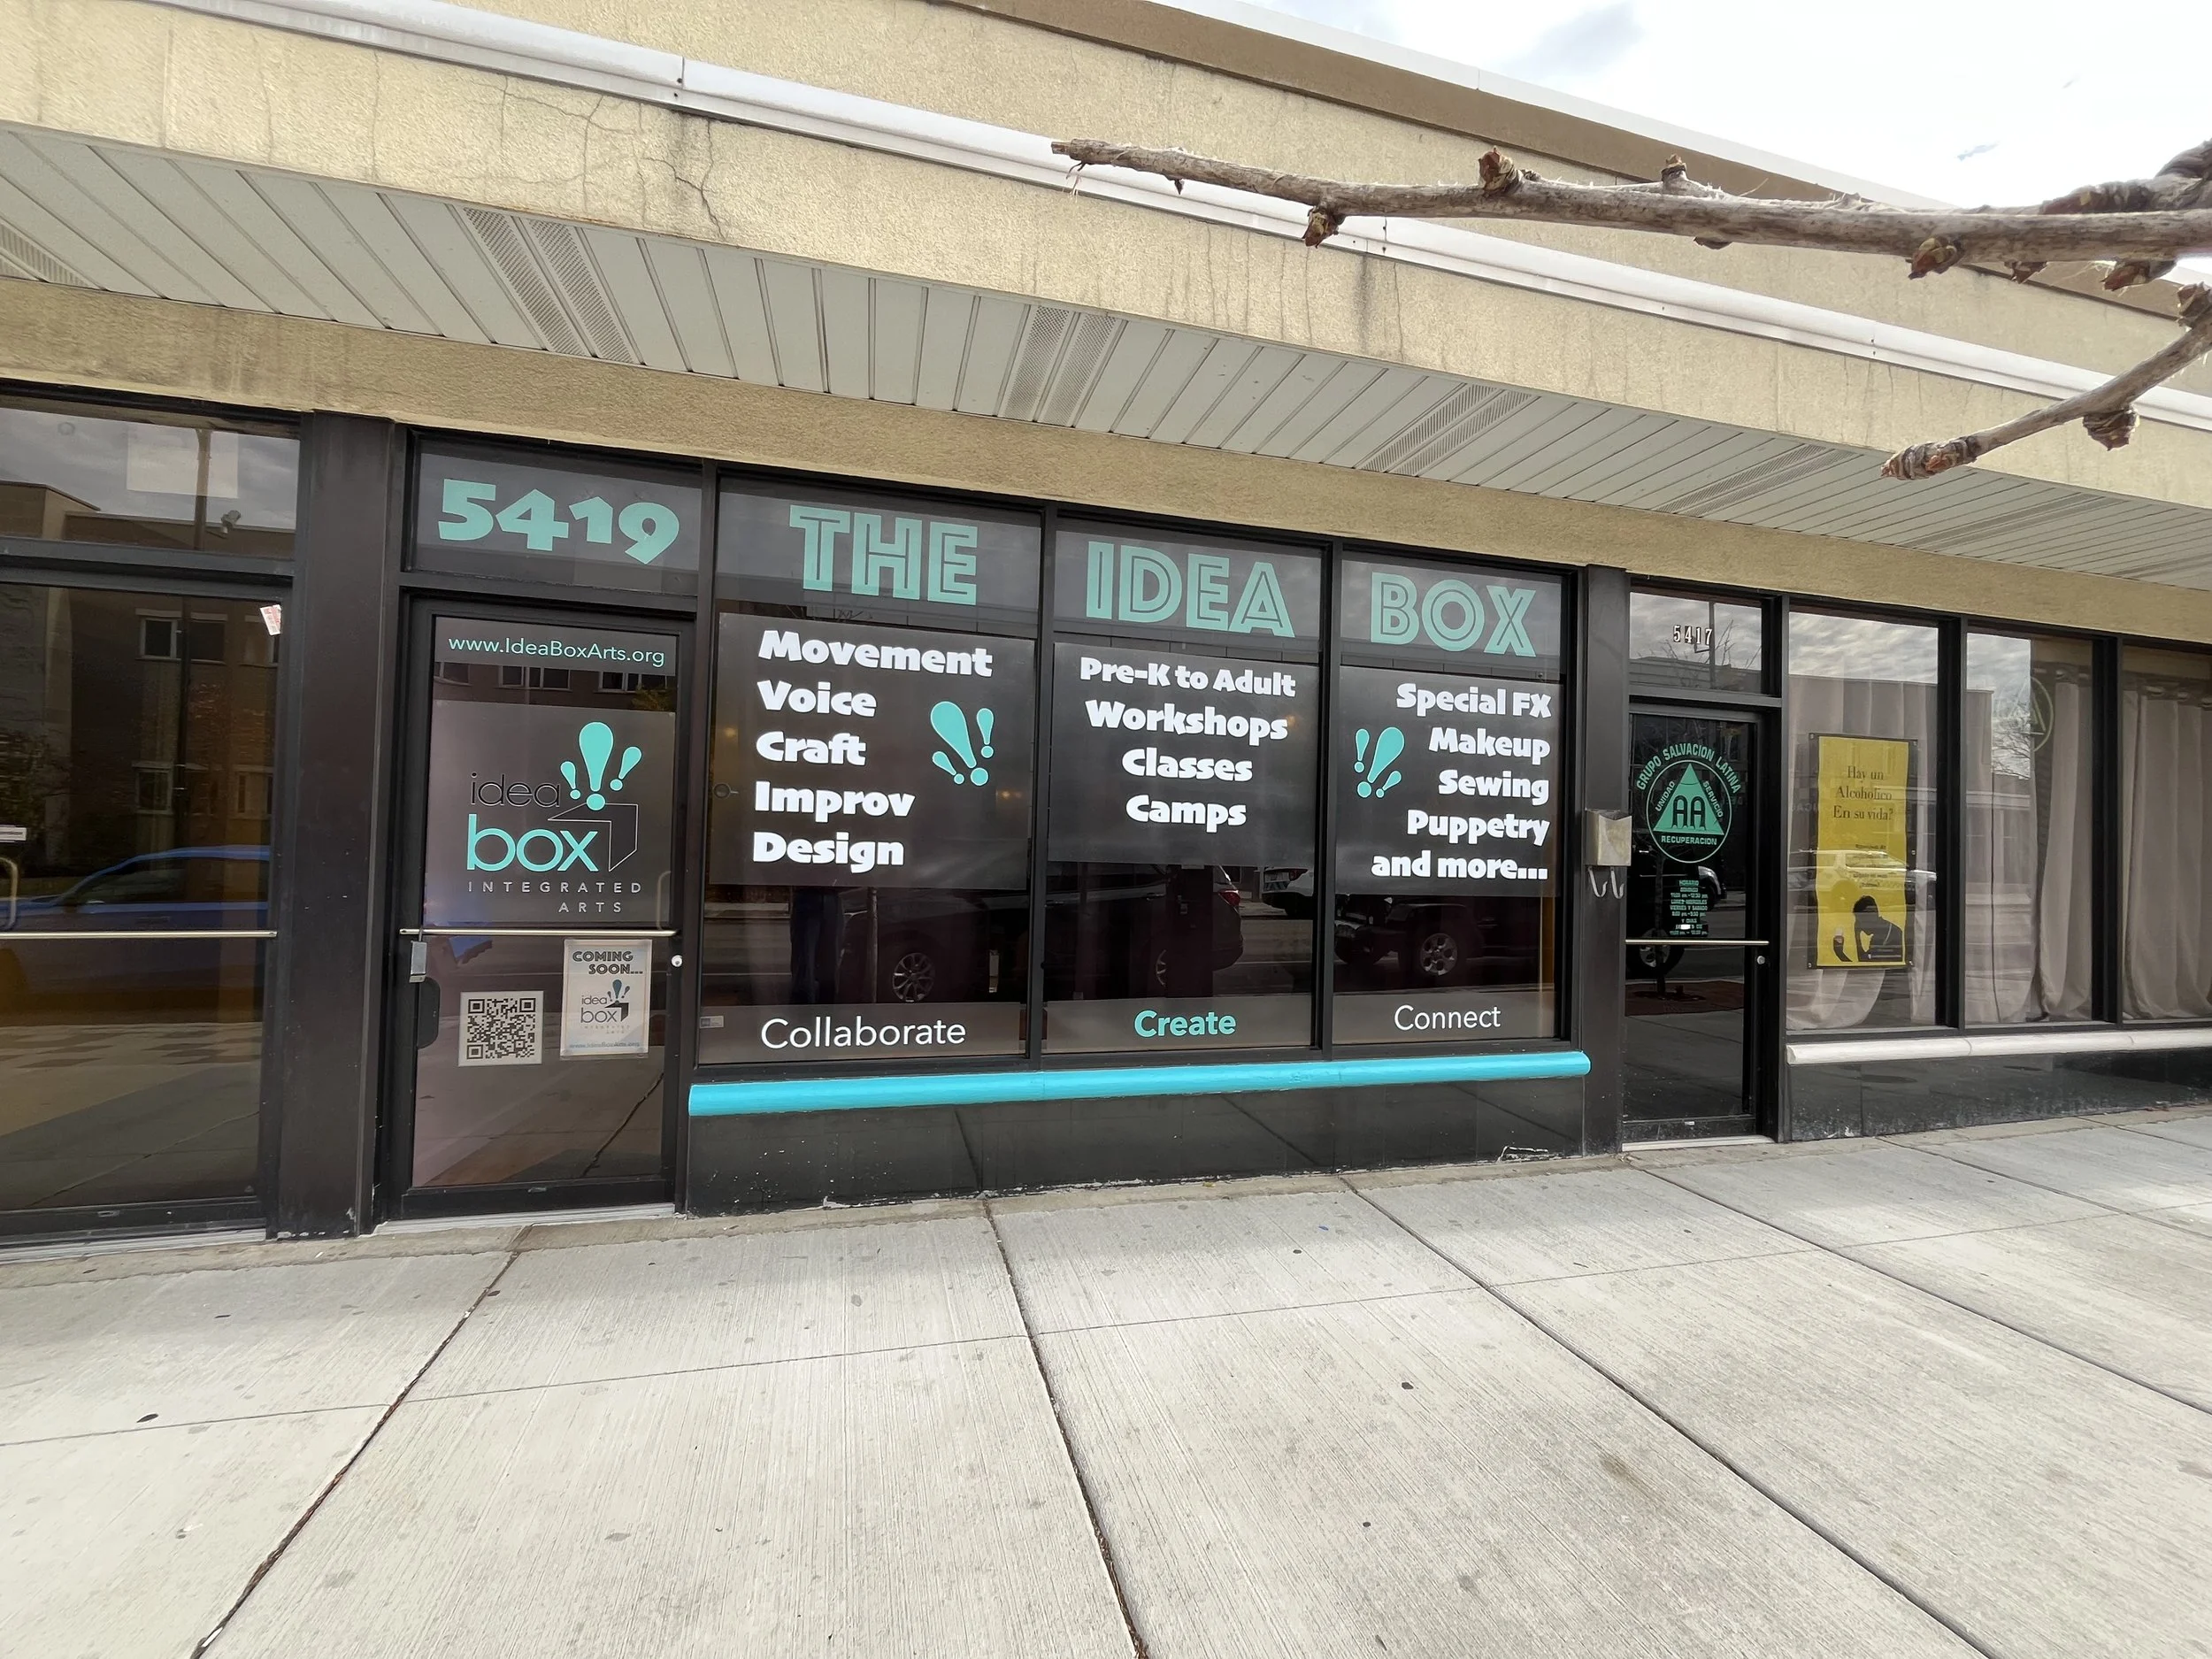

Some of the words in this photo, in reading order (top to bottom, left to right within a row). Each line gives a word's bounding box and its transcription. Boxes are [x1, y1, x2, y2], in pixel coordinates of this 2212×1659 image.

[438, 479, 680, 565] 5419
[789, 504, 978, 605] THE
[1086, 541, 1295, 638] IDEA
[1371, 572, 1537, 657] BOX
[449, 636, 664, 668] www.IdeaBoxArts.org
[1673, 624, 1713, 645] 5417
[758, 630, 993, 677] Movement
[1080, 657, 1171, 687] Pre-K
[1175, 665, 1209, 690] to
[1213, 669, 1296, 697] Adult
[757, 680, 877, 718] Voice
[1396, 683, 1506, 717] Special
[1512, 692, 1551, 718] FX
[1085, 700, 1288, 746] Workshops
[756, 731, 866, 766] Craft
[1428, 726, 1550, 765] Makeup
[1122, 747, 1253, 781] Classes
[1636, 755, 1662, 790] GRUPO
[1663, 743, 1715, 762] SALVACION
[1716, 756, 1741, 794] LATINA
[1847, 765, 1866, 782] Hay
[1870, 771, 1884, 780] un
[471, 772, 561, 807] idea
[755, 781, 916, 823] Improv
[1438, 769, 1549, 806] Sewing
[1655, 780, 1676, 811] UNIDAD
[1702, 780, 1724, 818] SERVICIO
[1125, 795, 1247, 833] Camps
[1407, 809, 1550, 847] Puppetry
[1671, 795, 1707, 831] AA
[1833, 805, 1850, 818] En
[1854, 810, 1865, 819] su
[1867, 808, 1893, 820] vida?
[467, 814, 598, 872] box
[753, 831, 905, 873] Design
[1661, 835, 1717, 845] RECUPERACION
[1371, 850, 1431, 878] and
[1437, 856, 1548, 879] more...
[468, 881, 641, 894] INTEGRATED
[558, 902, 622, 913] ARTS
[572, 951, 634, 962] COMING
[588, 964, 643, 974] SOON...
[580, 1007, 618, 1023] box
[581, 995, 608, 1005] idea
[761, 1016, 966, 1049] Collaborate
[1133, 1010, 1237, 1038] Create
[1394, 1004, 1502, 1032] Connect
